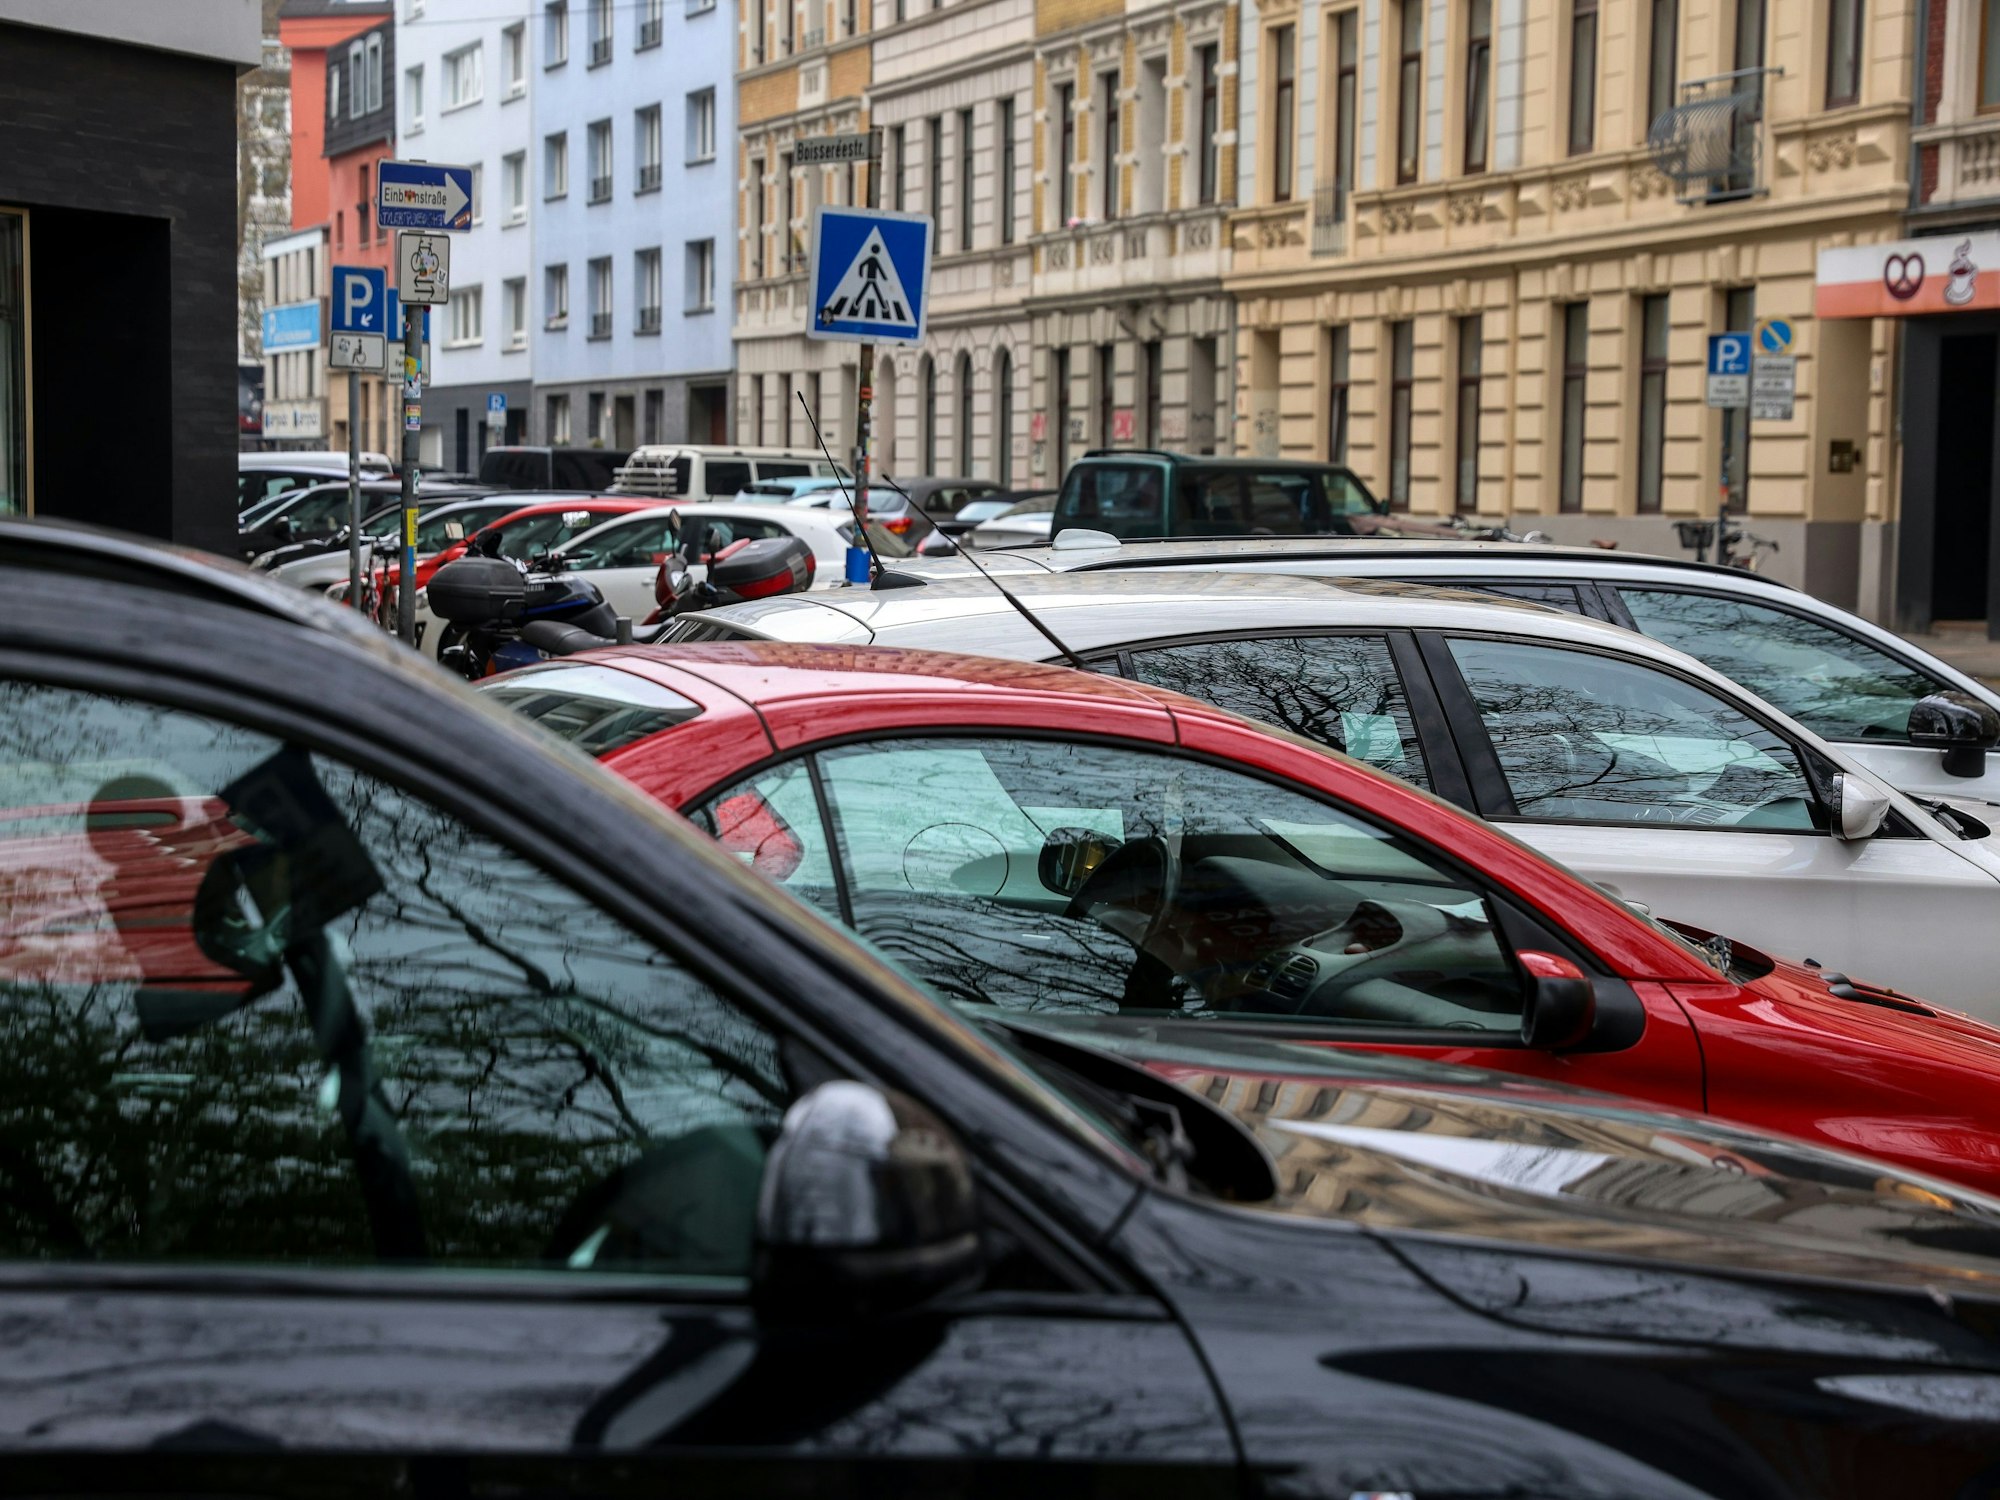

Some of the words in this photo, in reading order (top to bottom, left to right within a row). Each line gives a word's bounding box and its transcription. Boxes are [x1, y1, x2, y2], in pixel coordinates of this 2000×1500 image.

[797, 139, 865, 161] Boisseréestr.
[384, 187, 447, 206] Einbnstraße
[344, 275, 373, 327] P
[1717, 338, 1742, 374] P
